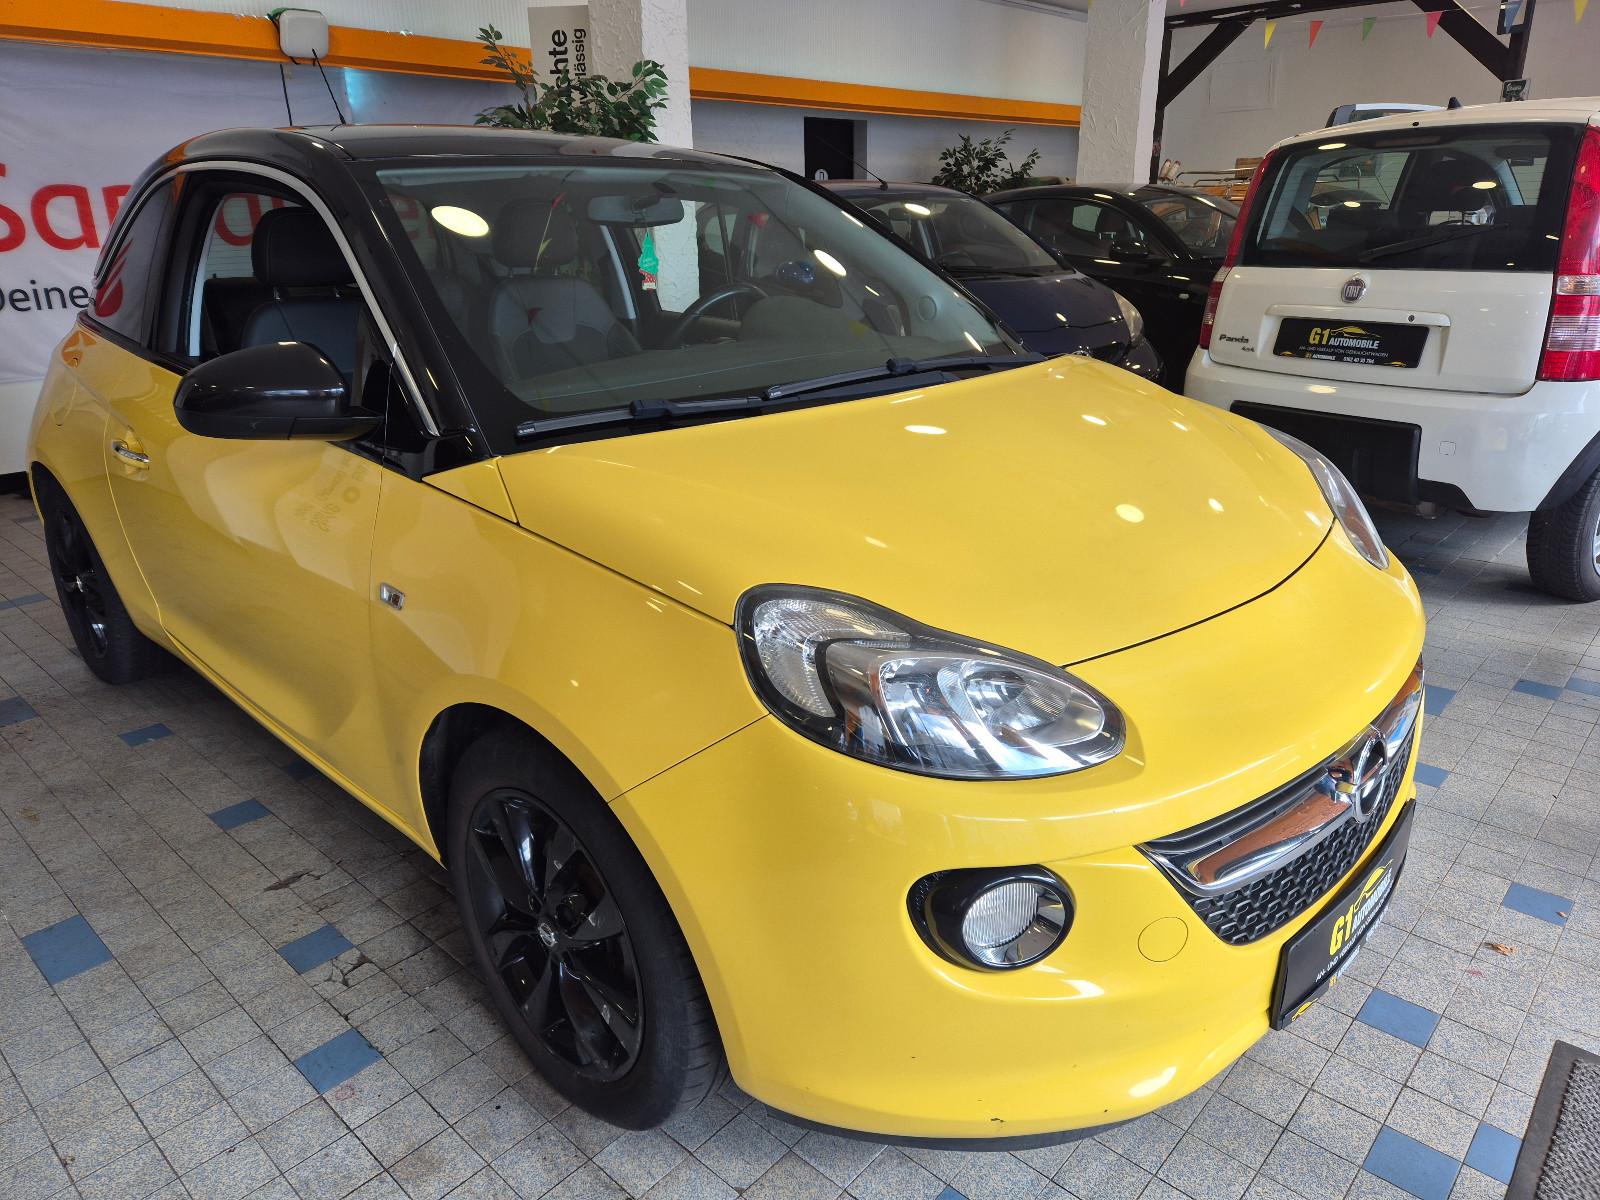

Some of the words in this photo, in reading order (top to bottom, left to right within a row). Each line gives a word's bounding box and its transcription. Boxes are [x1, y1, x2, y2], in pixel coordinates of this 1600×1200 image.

[0, 279, 89, 312] eine
[1219, 334, 1249, 343] Panda
[1309, 327, 1331, 345] G1
[1328, 337, 1380, 350] AUTOMOBILE
[1329, 904, 1354, 956] G1
